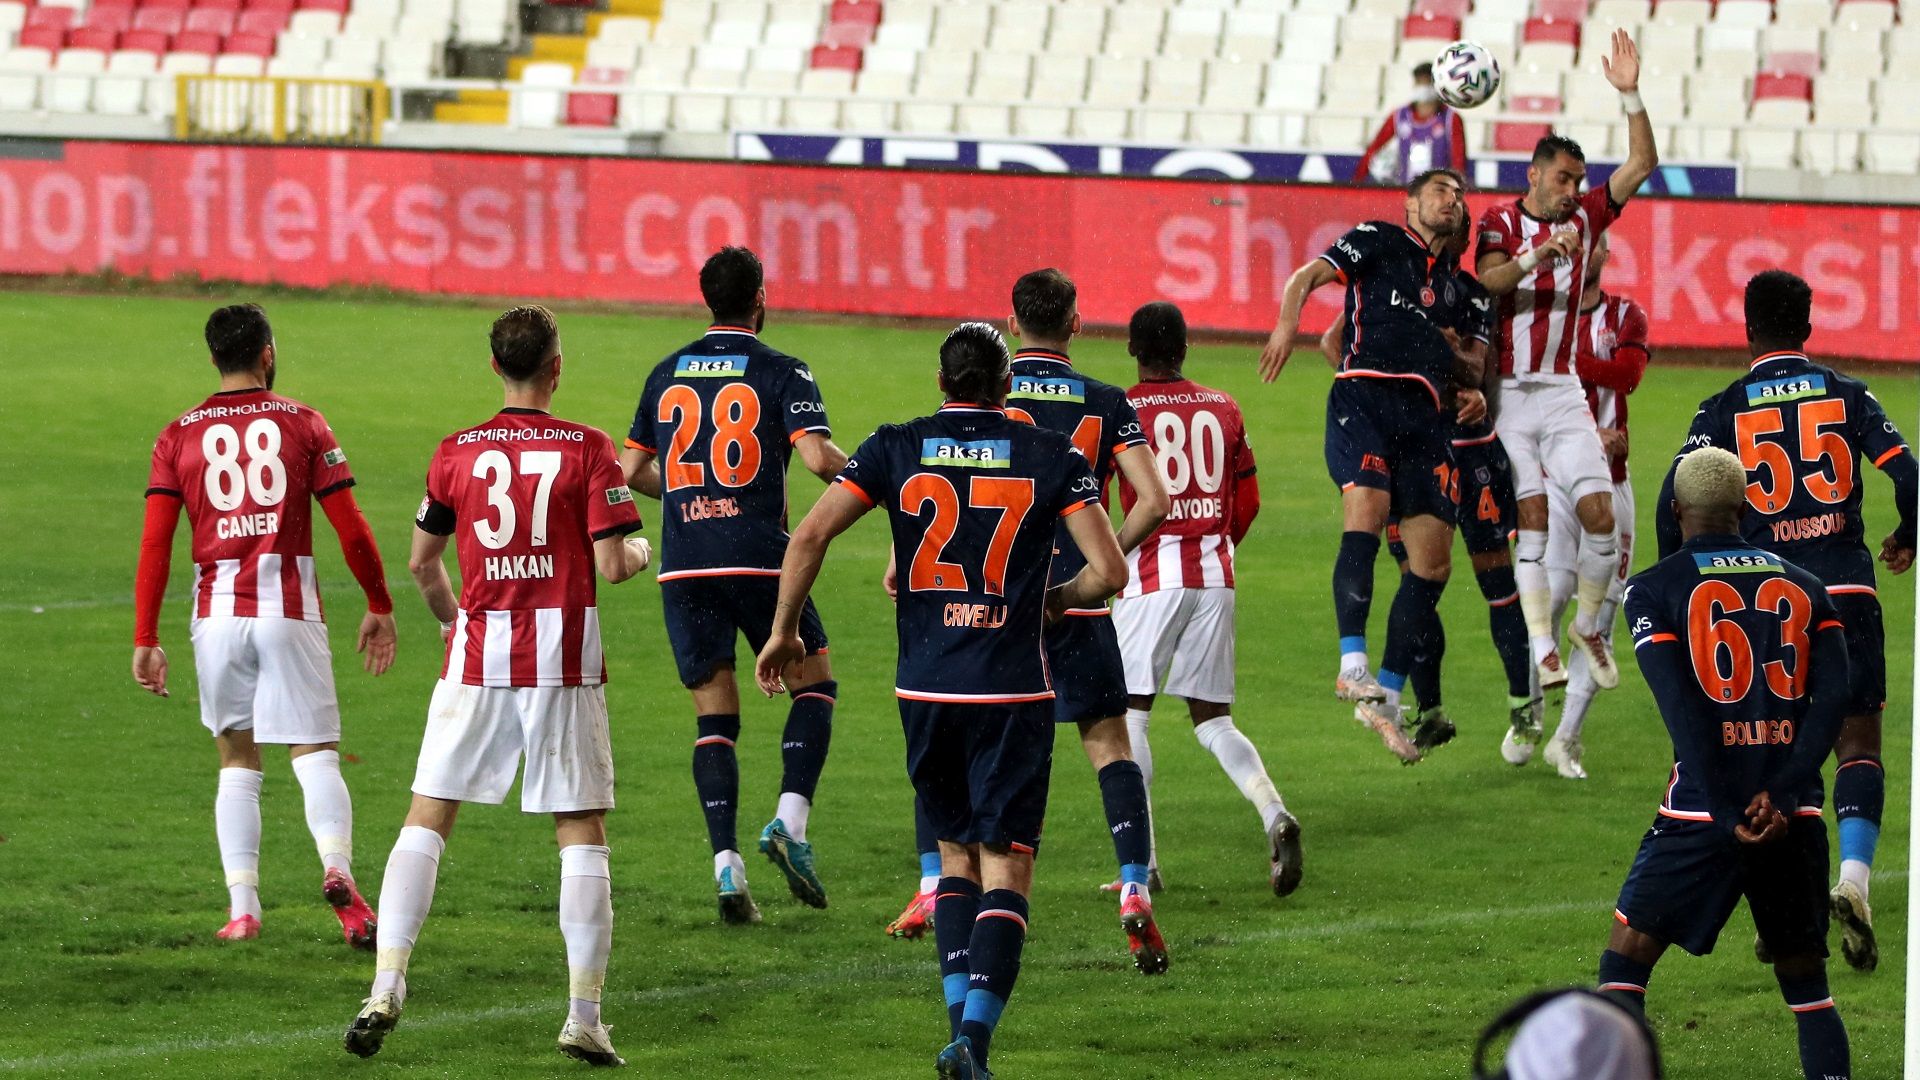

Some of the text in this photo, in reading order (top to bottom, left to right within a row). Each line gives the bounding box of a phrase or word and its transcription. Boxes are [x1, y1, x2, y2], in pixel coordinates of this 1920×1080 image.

[688, 359, 733, 372] aksa
[1019, 381, 1070, 396] aksa
[1131, 392, 1226, 409] EMiRHOLDiNG
[1761, 378, 1811, 398] aksa
[657, 382, 762, 493] 28
[202, 418, 288, 512] 88
[937, 445, 994, 461] aksa
[1152, 410, 1225, 496] 80
[1734, 398, 1854, 515] 55
[472, 450, 562, 550] 37
[1165, 497, 1223, 520] AYODE
[1477, 486, 1501, 524] 4
[216, 512, 279, 540] CANER
[899, 472, 1035, 597] 27
[485, 554, 554, 581] HAKAN
[1712, 553, 1768, 568] aksa
[943, 602, 1008, 629] CRIVELLI
[1687, 577, 1812, 704] 63
[1722, 719, 1793, 746] BOLINGO
